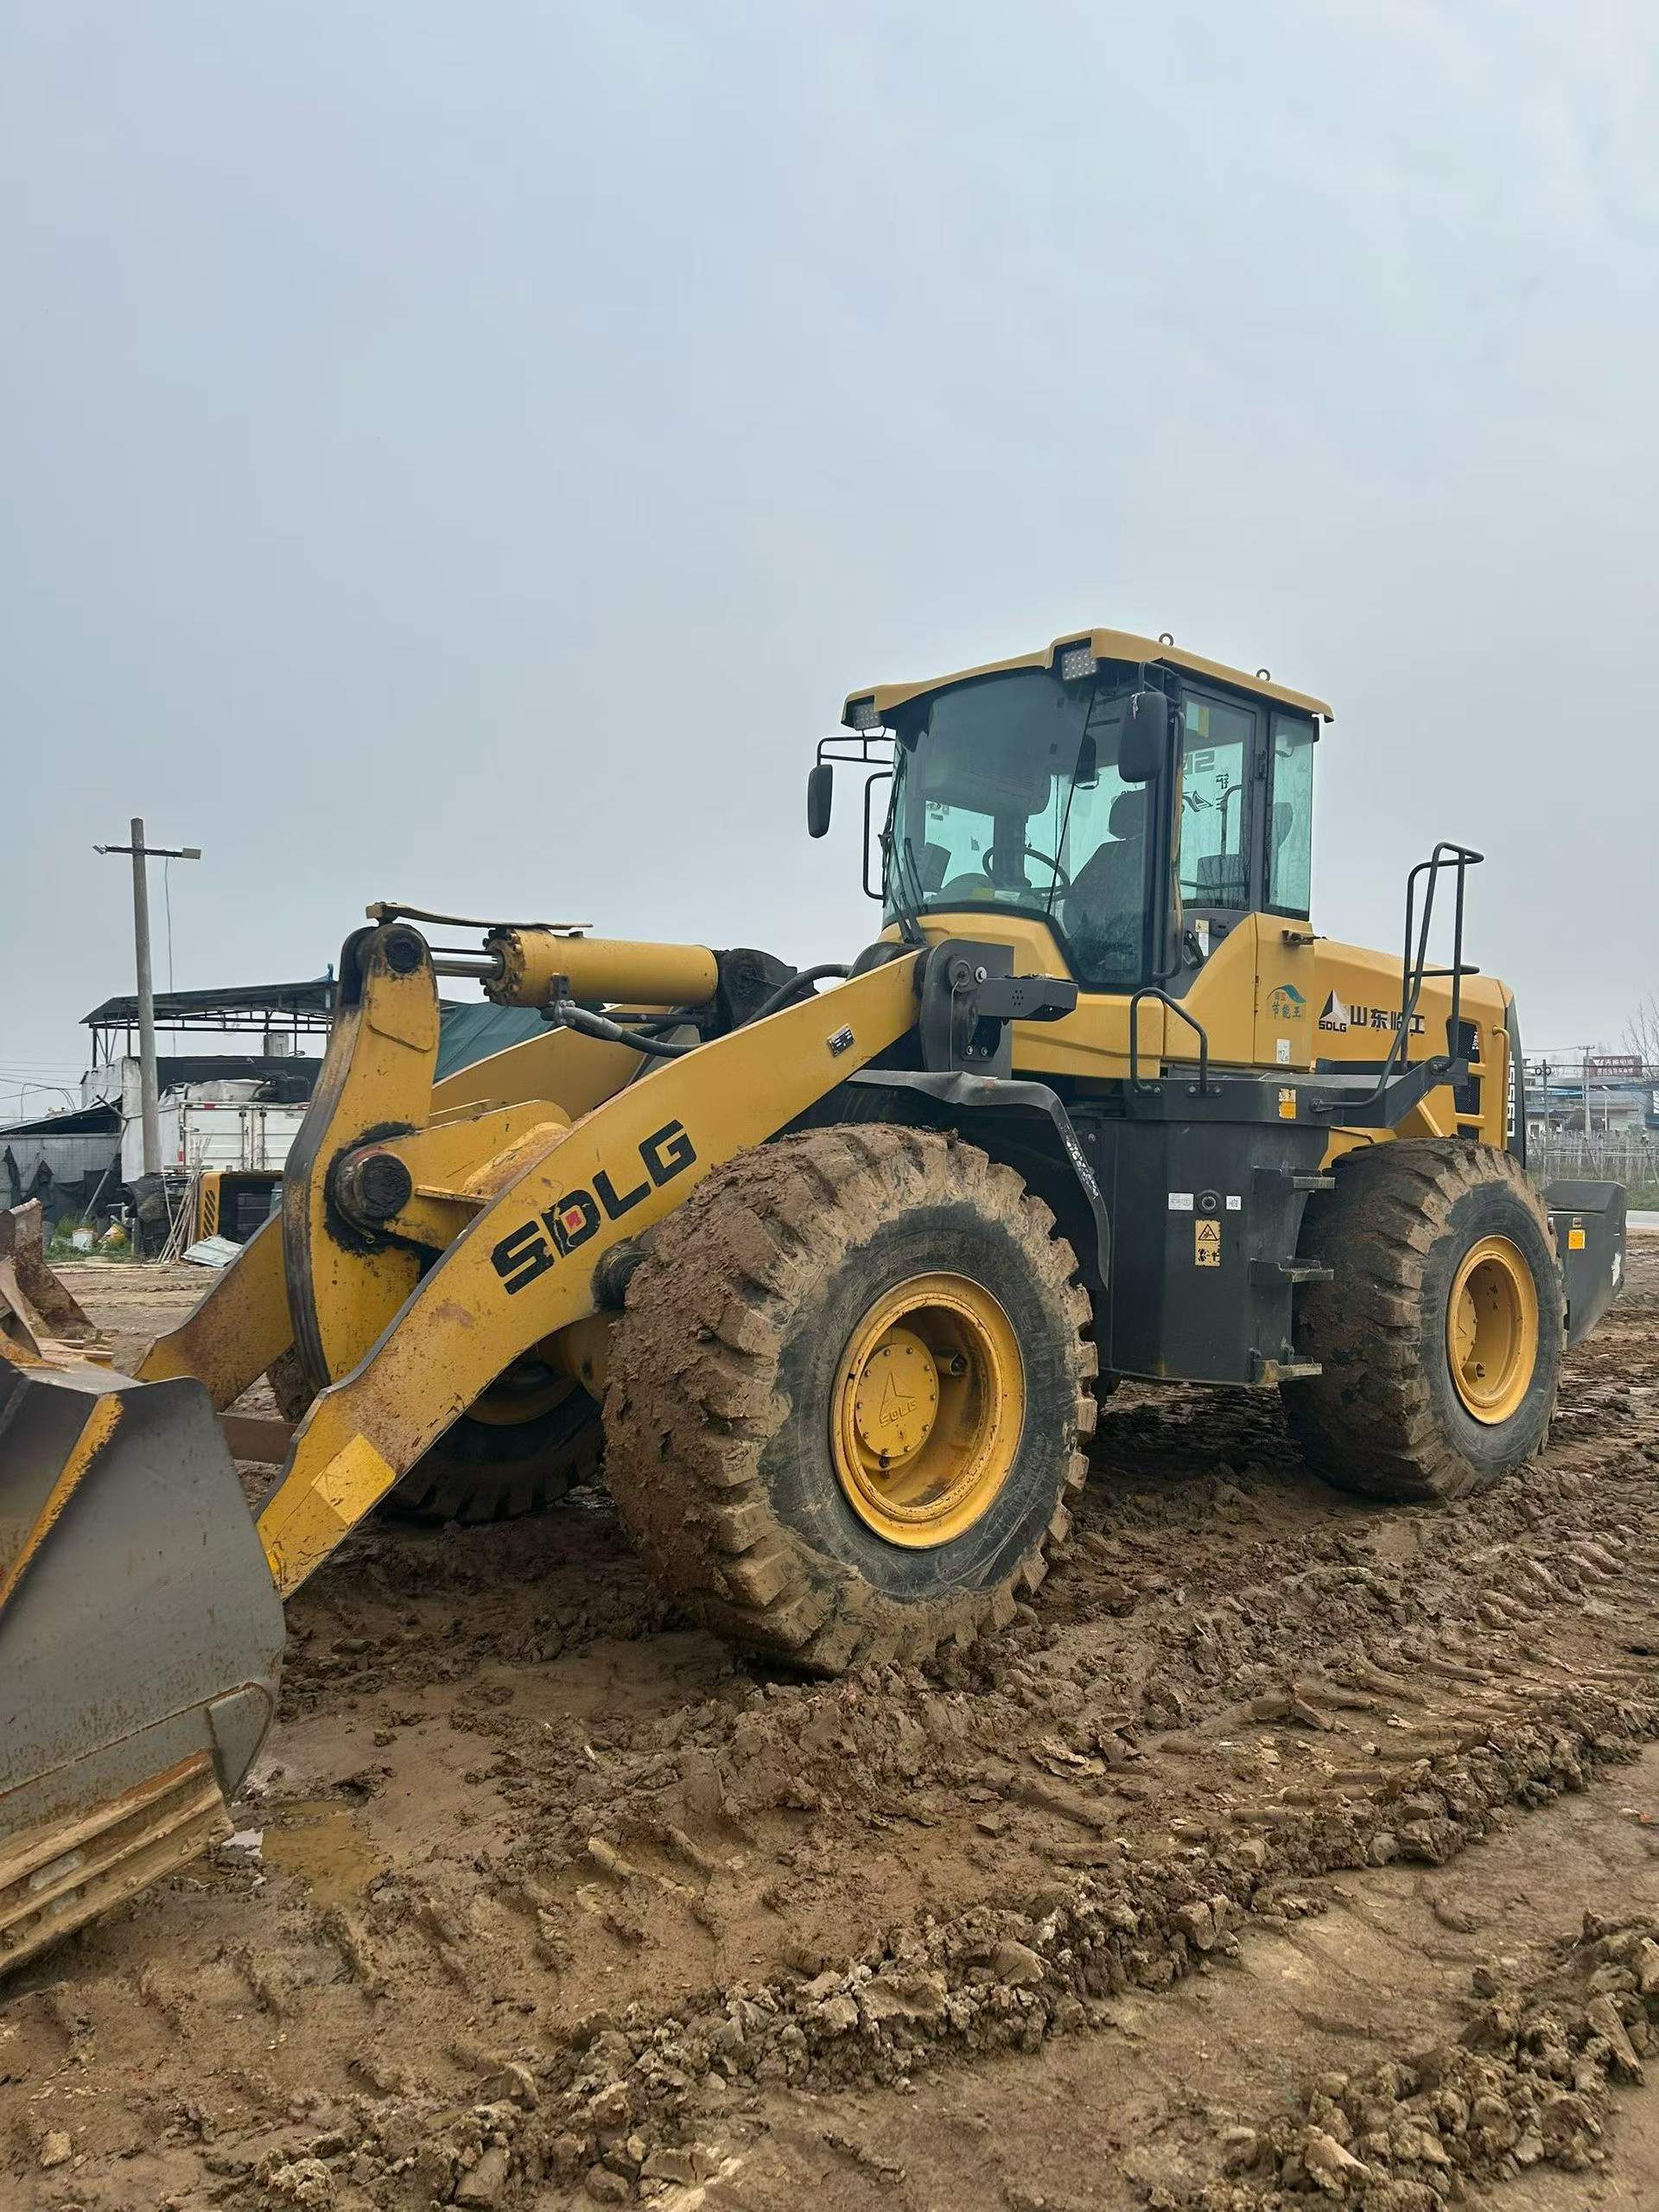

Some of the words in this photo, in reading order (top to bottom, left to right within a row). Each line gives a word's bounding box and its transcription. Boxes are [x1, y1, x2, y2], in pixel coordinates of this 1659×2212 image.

[1319, 1020, 1347, 1033] SDLG
[1351, 1006, 1425, 1034] 山东临工
[491, 1119, 697, 1295] SDLG
